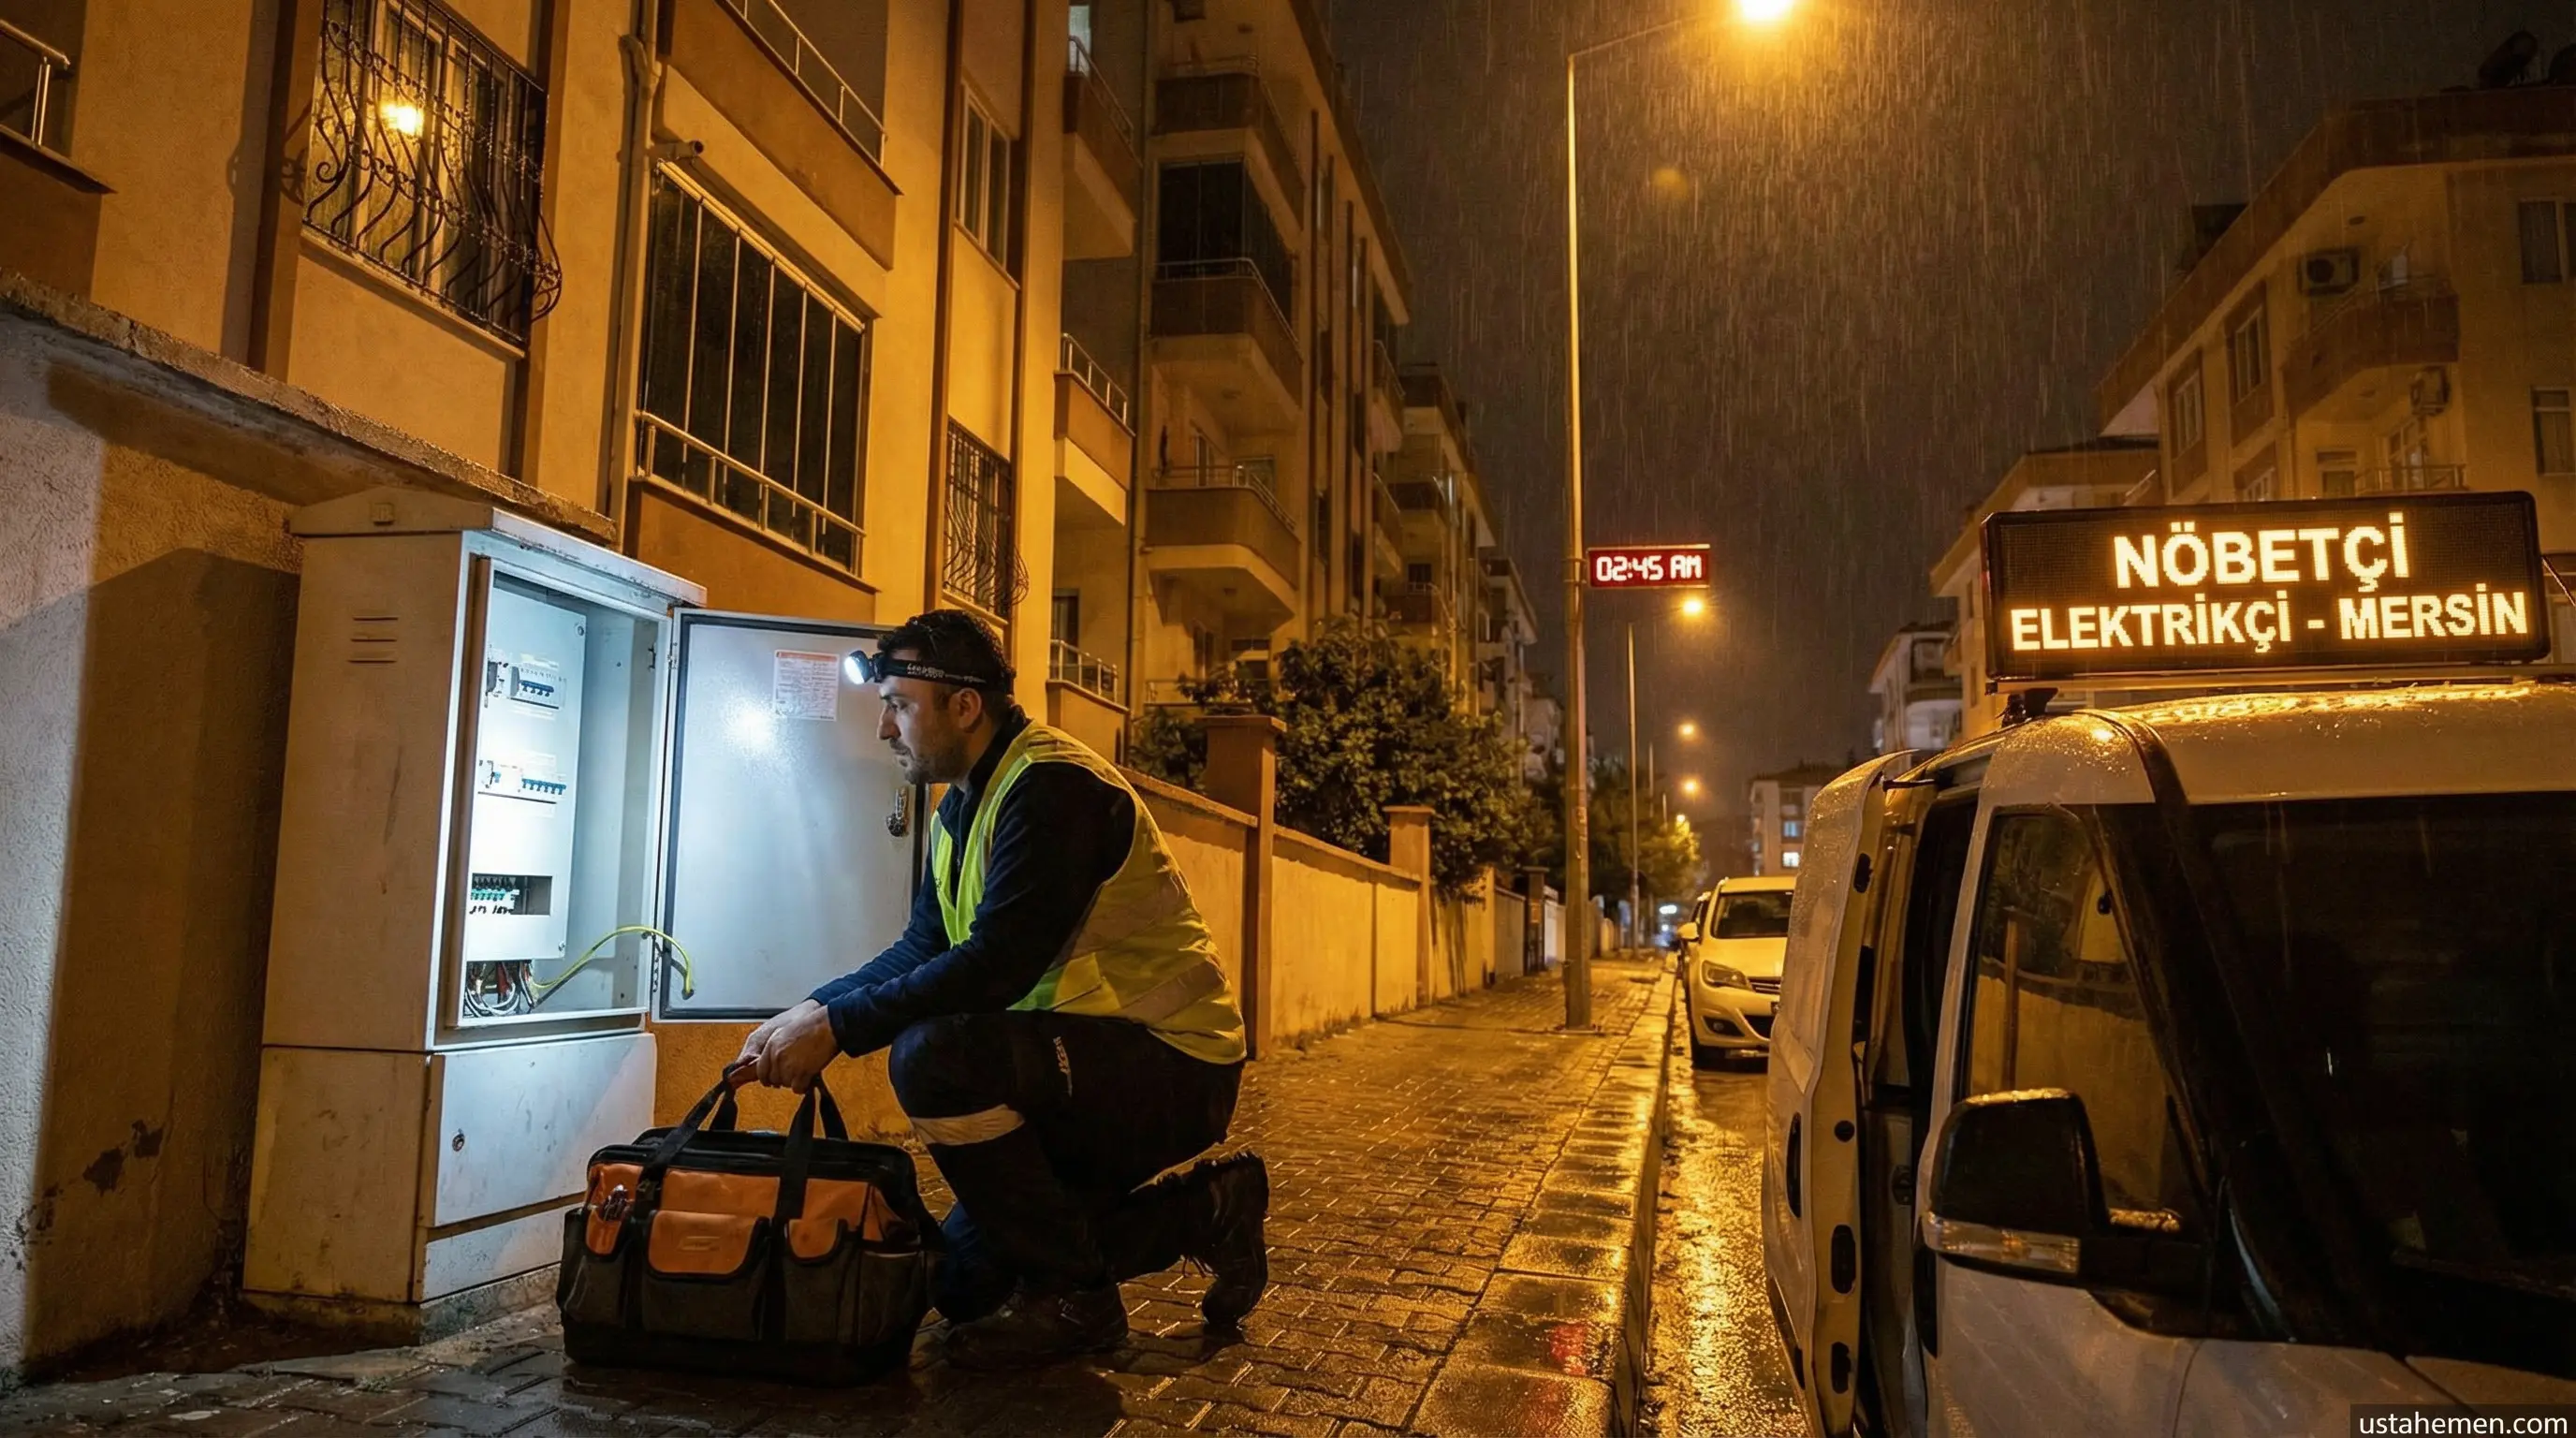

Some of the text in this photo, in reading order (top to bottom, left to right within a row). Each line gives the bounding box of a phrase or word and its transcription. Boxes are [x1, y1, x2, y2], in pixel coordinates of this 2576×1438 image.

[1596, 554, 1702, 581] 02:45 AM
[2113, 512, 2410, 592] NÖBETÇİ
[2010, 582, 2528, 653] ELEKTRİKÇİ - MERSİN
